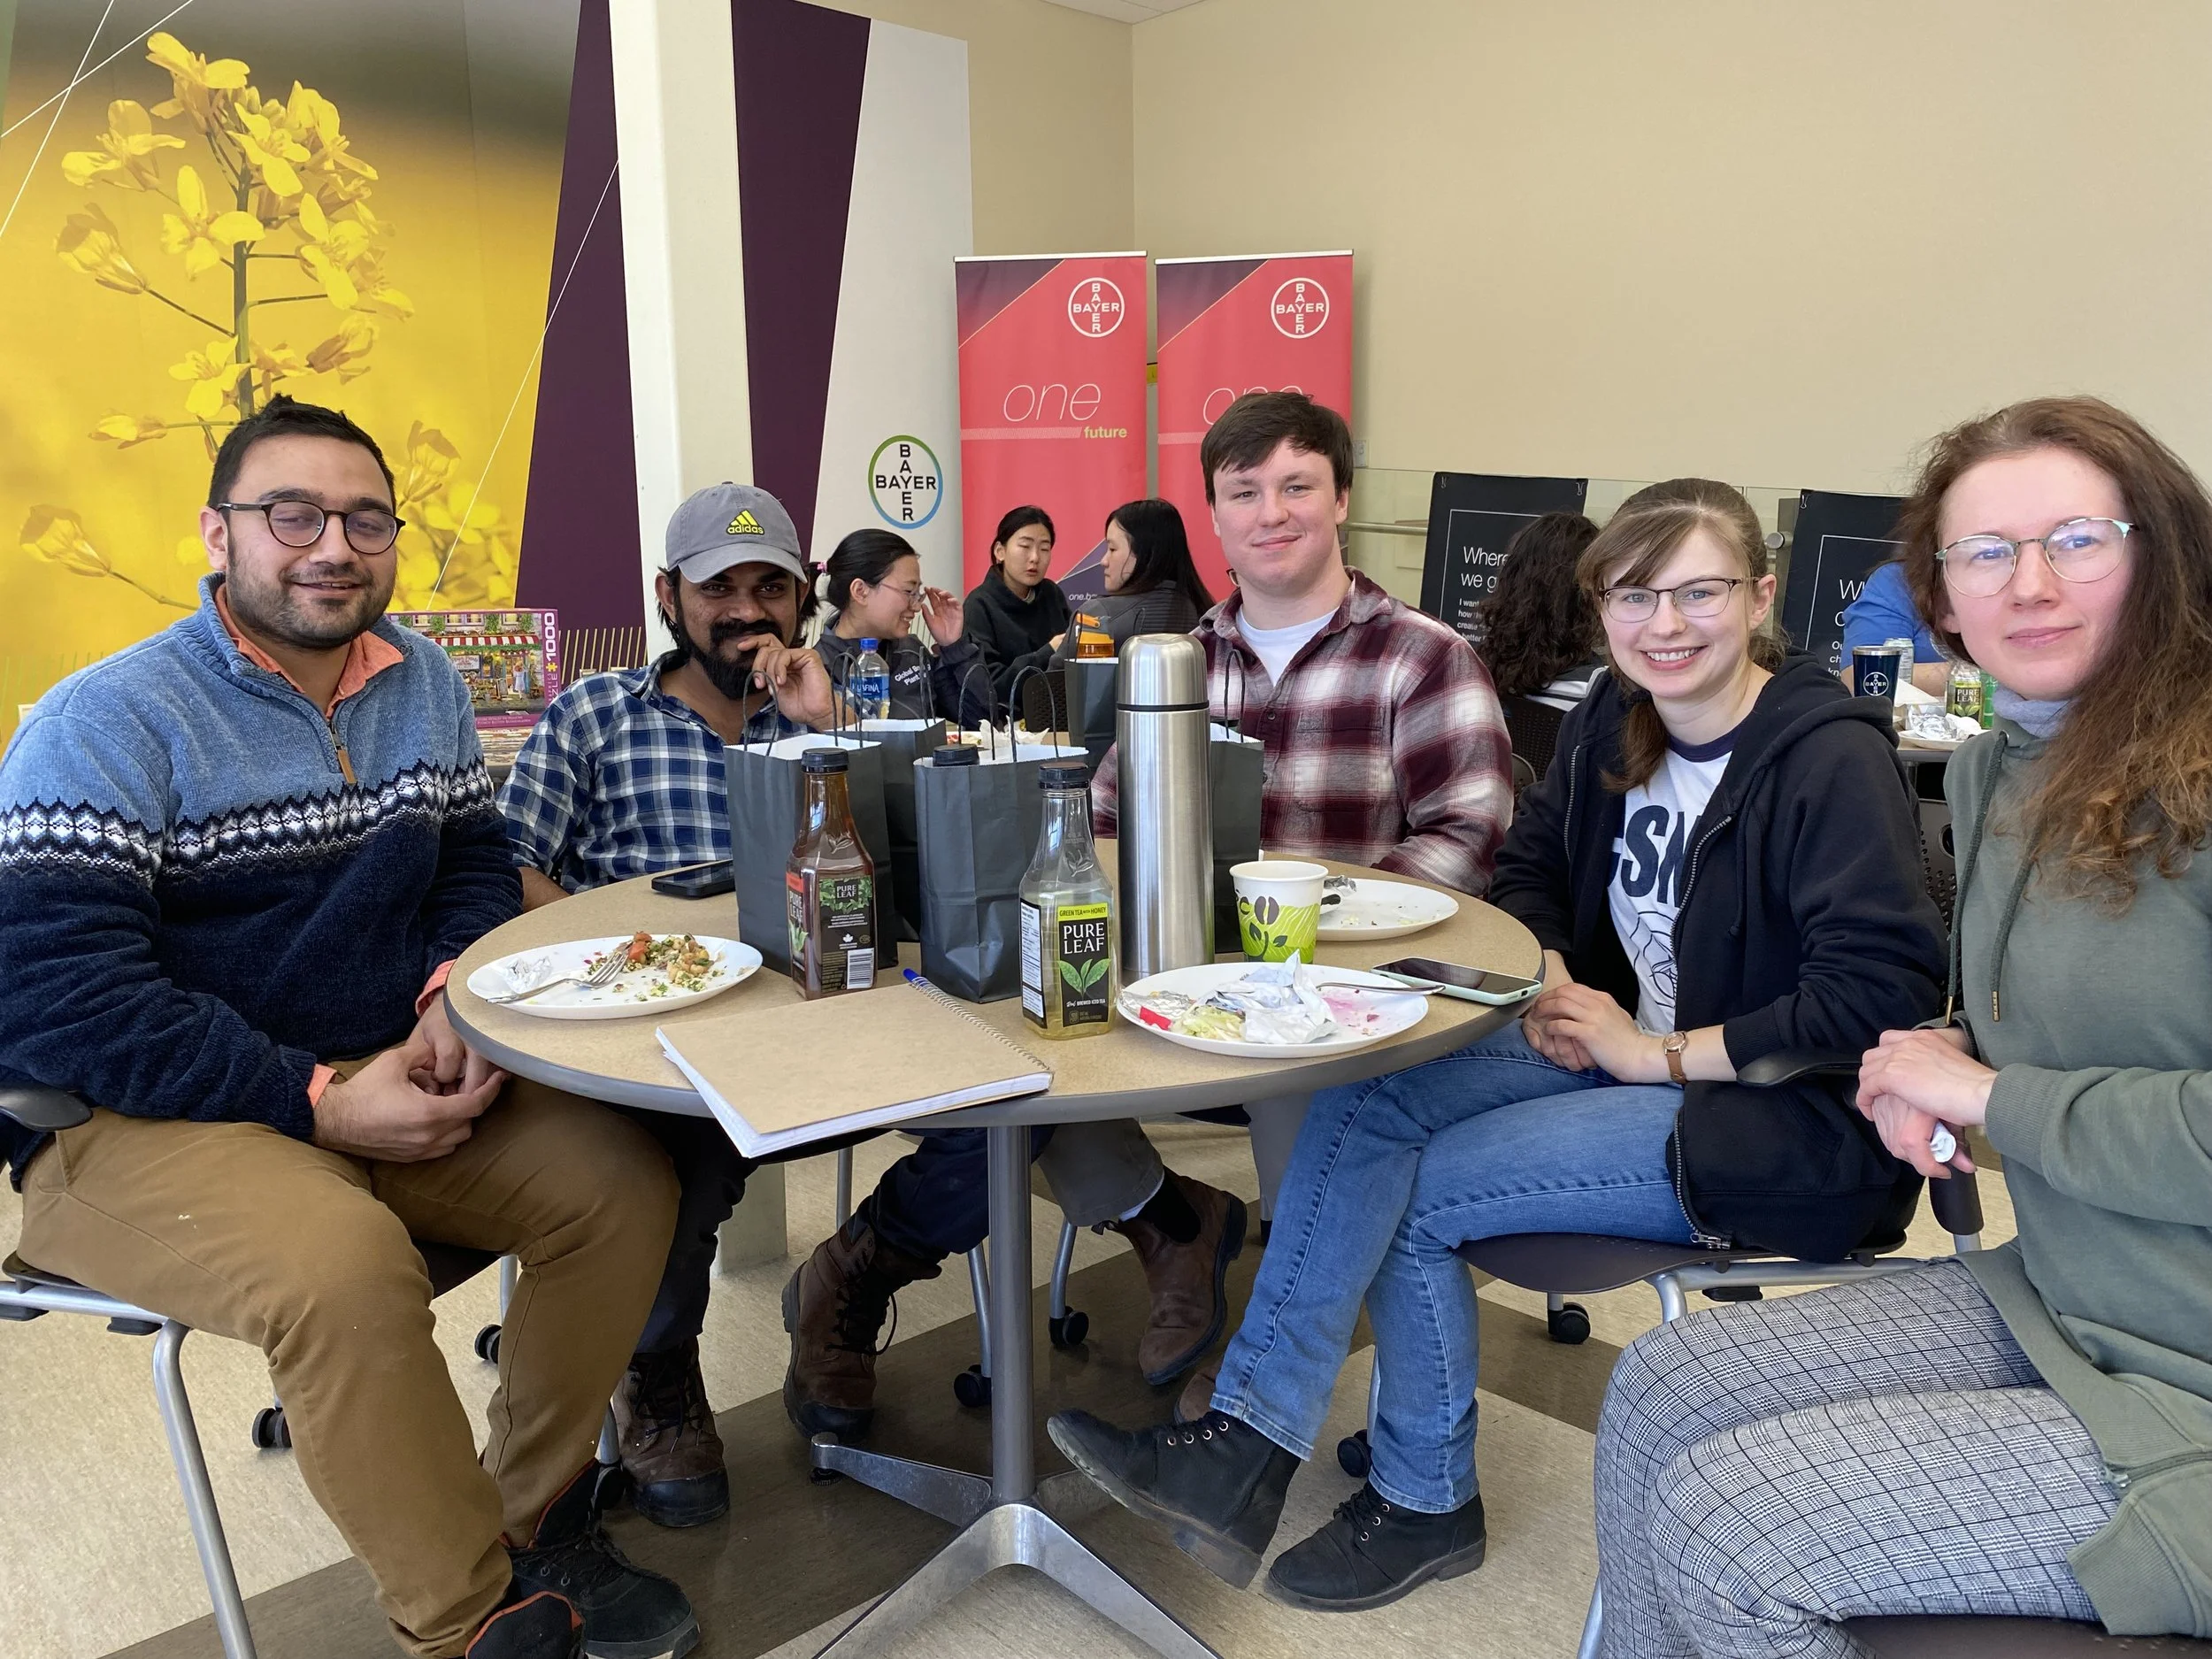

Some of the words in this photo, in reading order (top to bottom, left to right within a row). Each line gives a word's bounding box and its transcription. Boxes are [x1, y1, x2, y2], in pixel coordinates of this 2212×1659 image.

[1073, 303, 1120, 313] BAYER
[1091, 283, 1101, 333] BAYER
[1276, 303, 1325, 314] BAYER
[1295, 283, 1305, 334] BAYER
[1003, 383, 1101, 422] one
[1084, 426, 1127, 438] future
[875, 475, 937, 489] BAYER
[899, 444, 914, 521] BAYER
[727, 525, 764, 534] adidas
[1461, 573, 1483, 588] we
[1458, 610, 1472, 618] how
[544, 612, 557, 662] 1000
[895, 667, 913, 681] Global
[1064, 922, 1105, 940] PURE
[1064, 937, 1105, 955] LEAF
